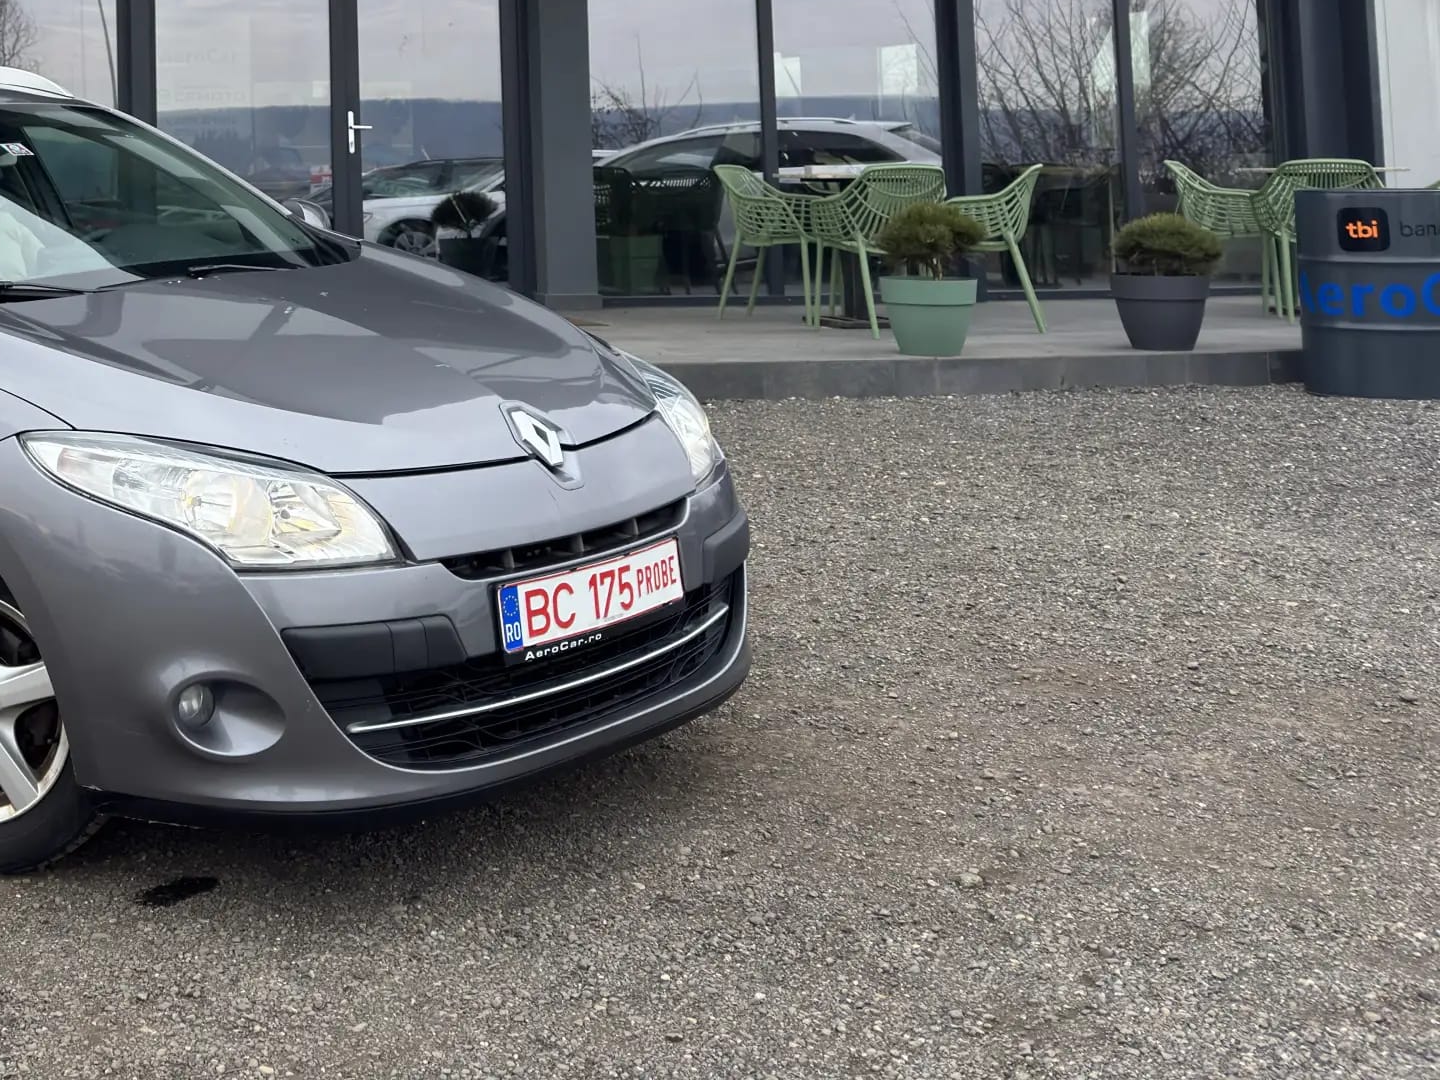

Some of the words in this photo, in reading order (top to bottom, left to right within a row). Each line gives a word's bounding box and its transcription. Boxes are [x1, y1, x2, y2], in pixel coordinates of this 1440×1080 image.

[1344, 220, 1380, 239] tbi
[1399, 220, 1440, 238] ban
[524, 582, 576, 639] BC
[588, 565, 636, 620] 175
[636, 555, 678, 599] PROBE
[505, 620, 522, 643] RO
[524, 632, 603, 661] AeroCar.ro
